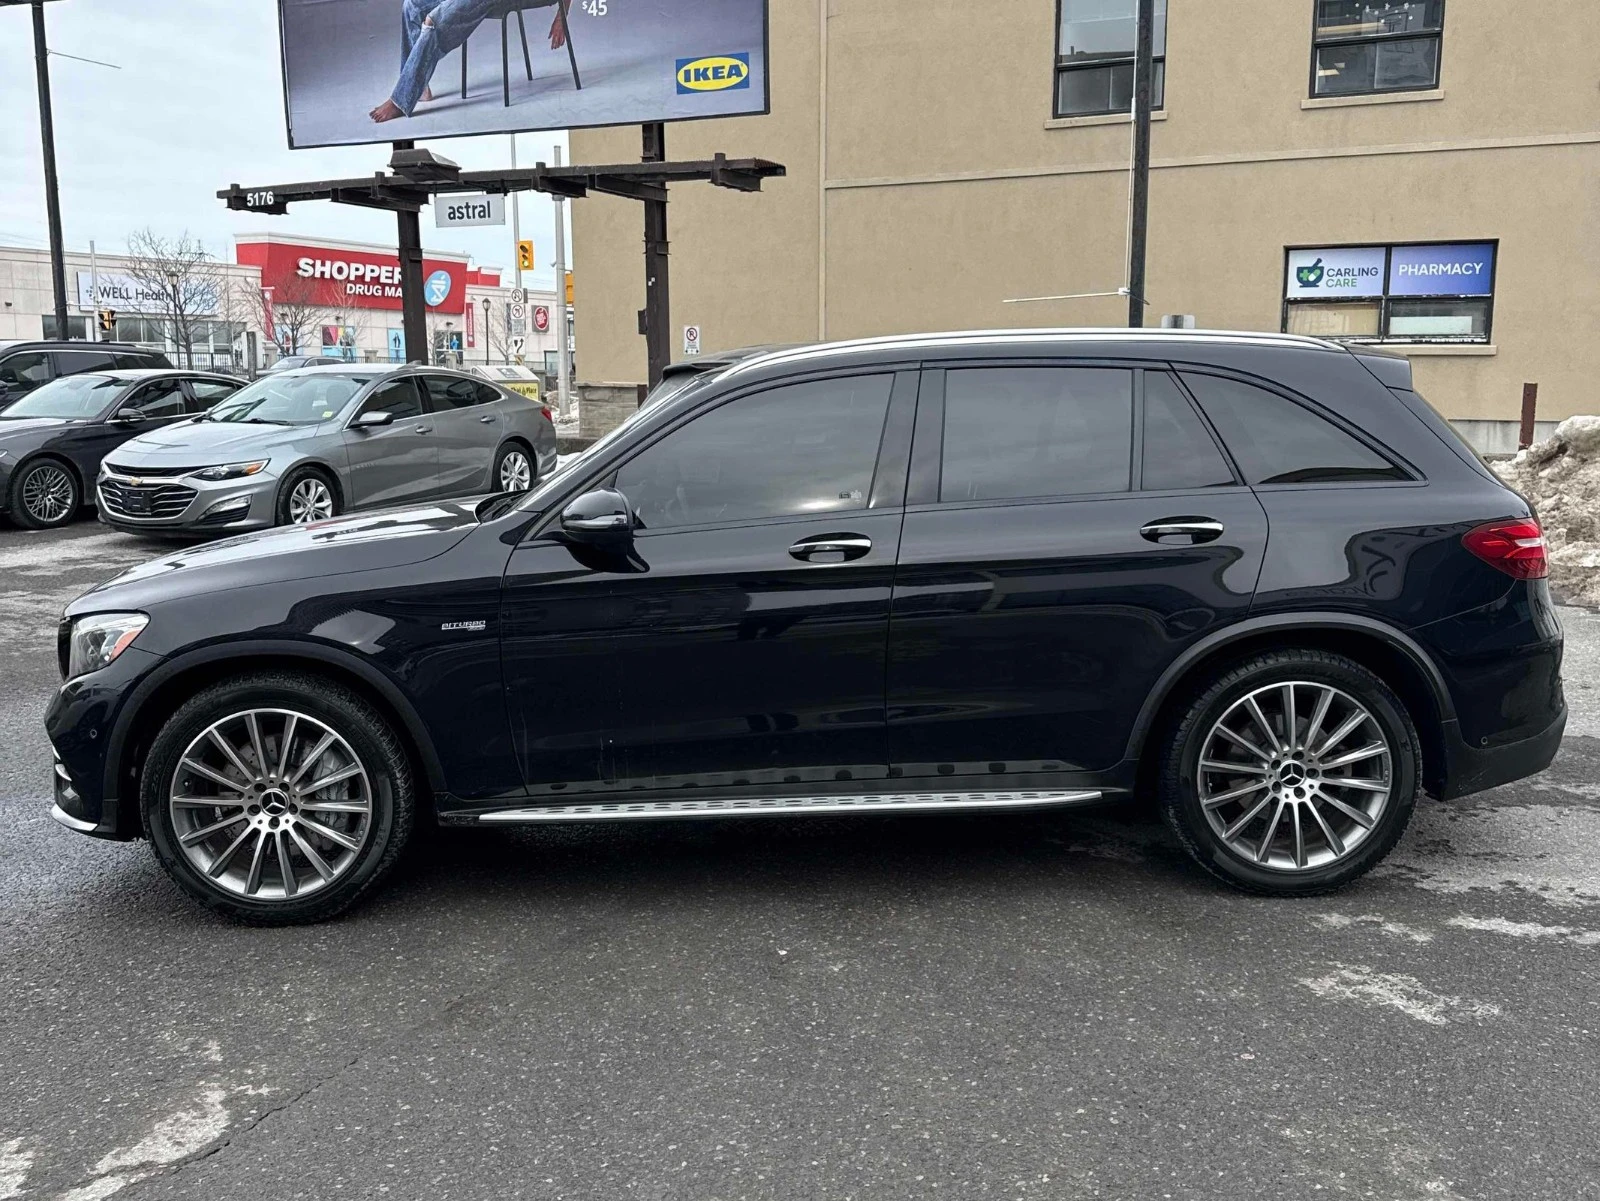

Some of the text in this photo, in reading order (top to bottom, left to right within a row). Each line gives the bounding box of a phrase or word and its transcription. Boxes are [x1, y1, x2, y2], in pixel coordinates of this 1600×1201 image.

[582, 0, 608, 16] $45
[683, 64, 743, 82] IKEA
[246, 191, 274, 207] 5176
[447, 200, 491, 221] astral
[296, 257, 402, 285] SHOPPER
[1326, 266, 1379, 278] CARLING
[1398, 262, 1484, 276] PHARMACY
[346, 283, 403, 298] DRUG MA
[1325, 278, 1357, 288] CARE
[98, 286, 133, 300] WELL
[135, 288, 172, 301] Health
